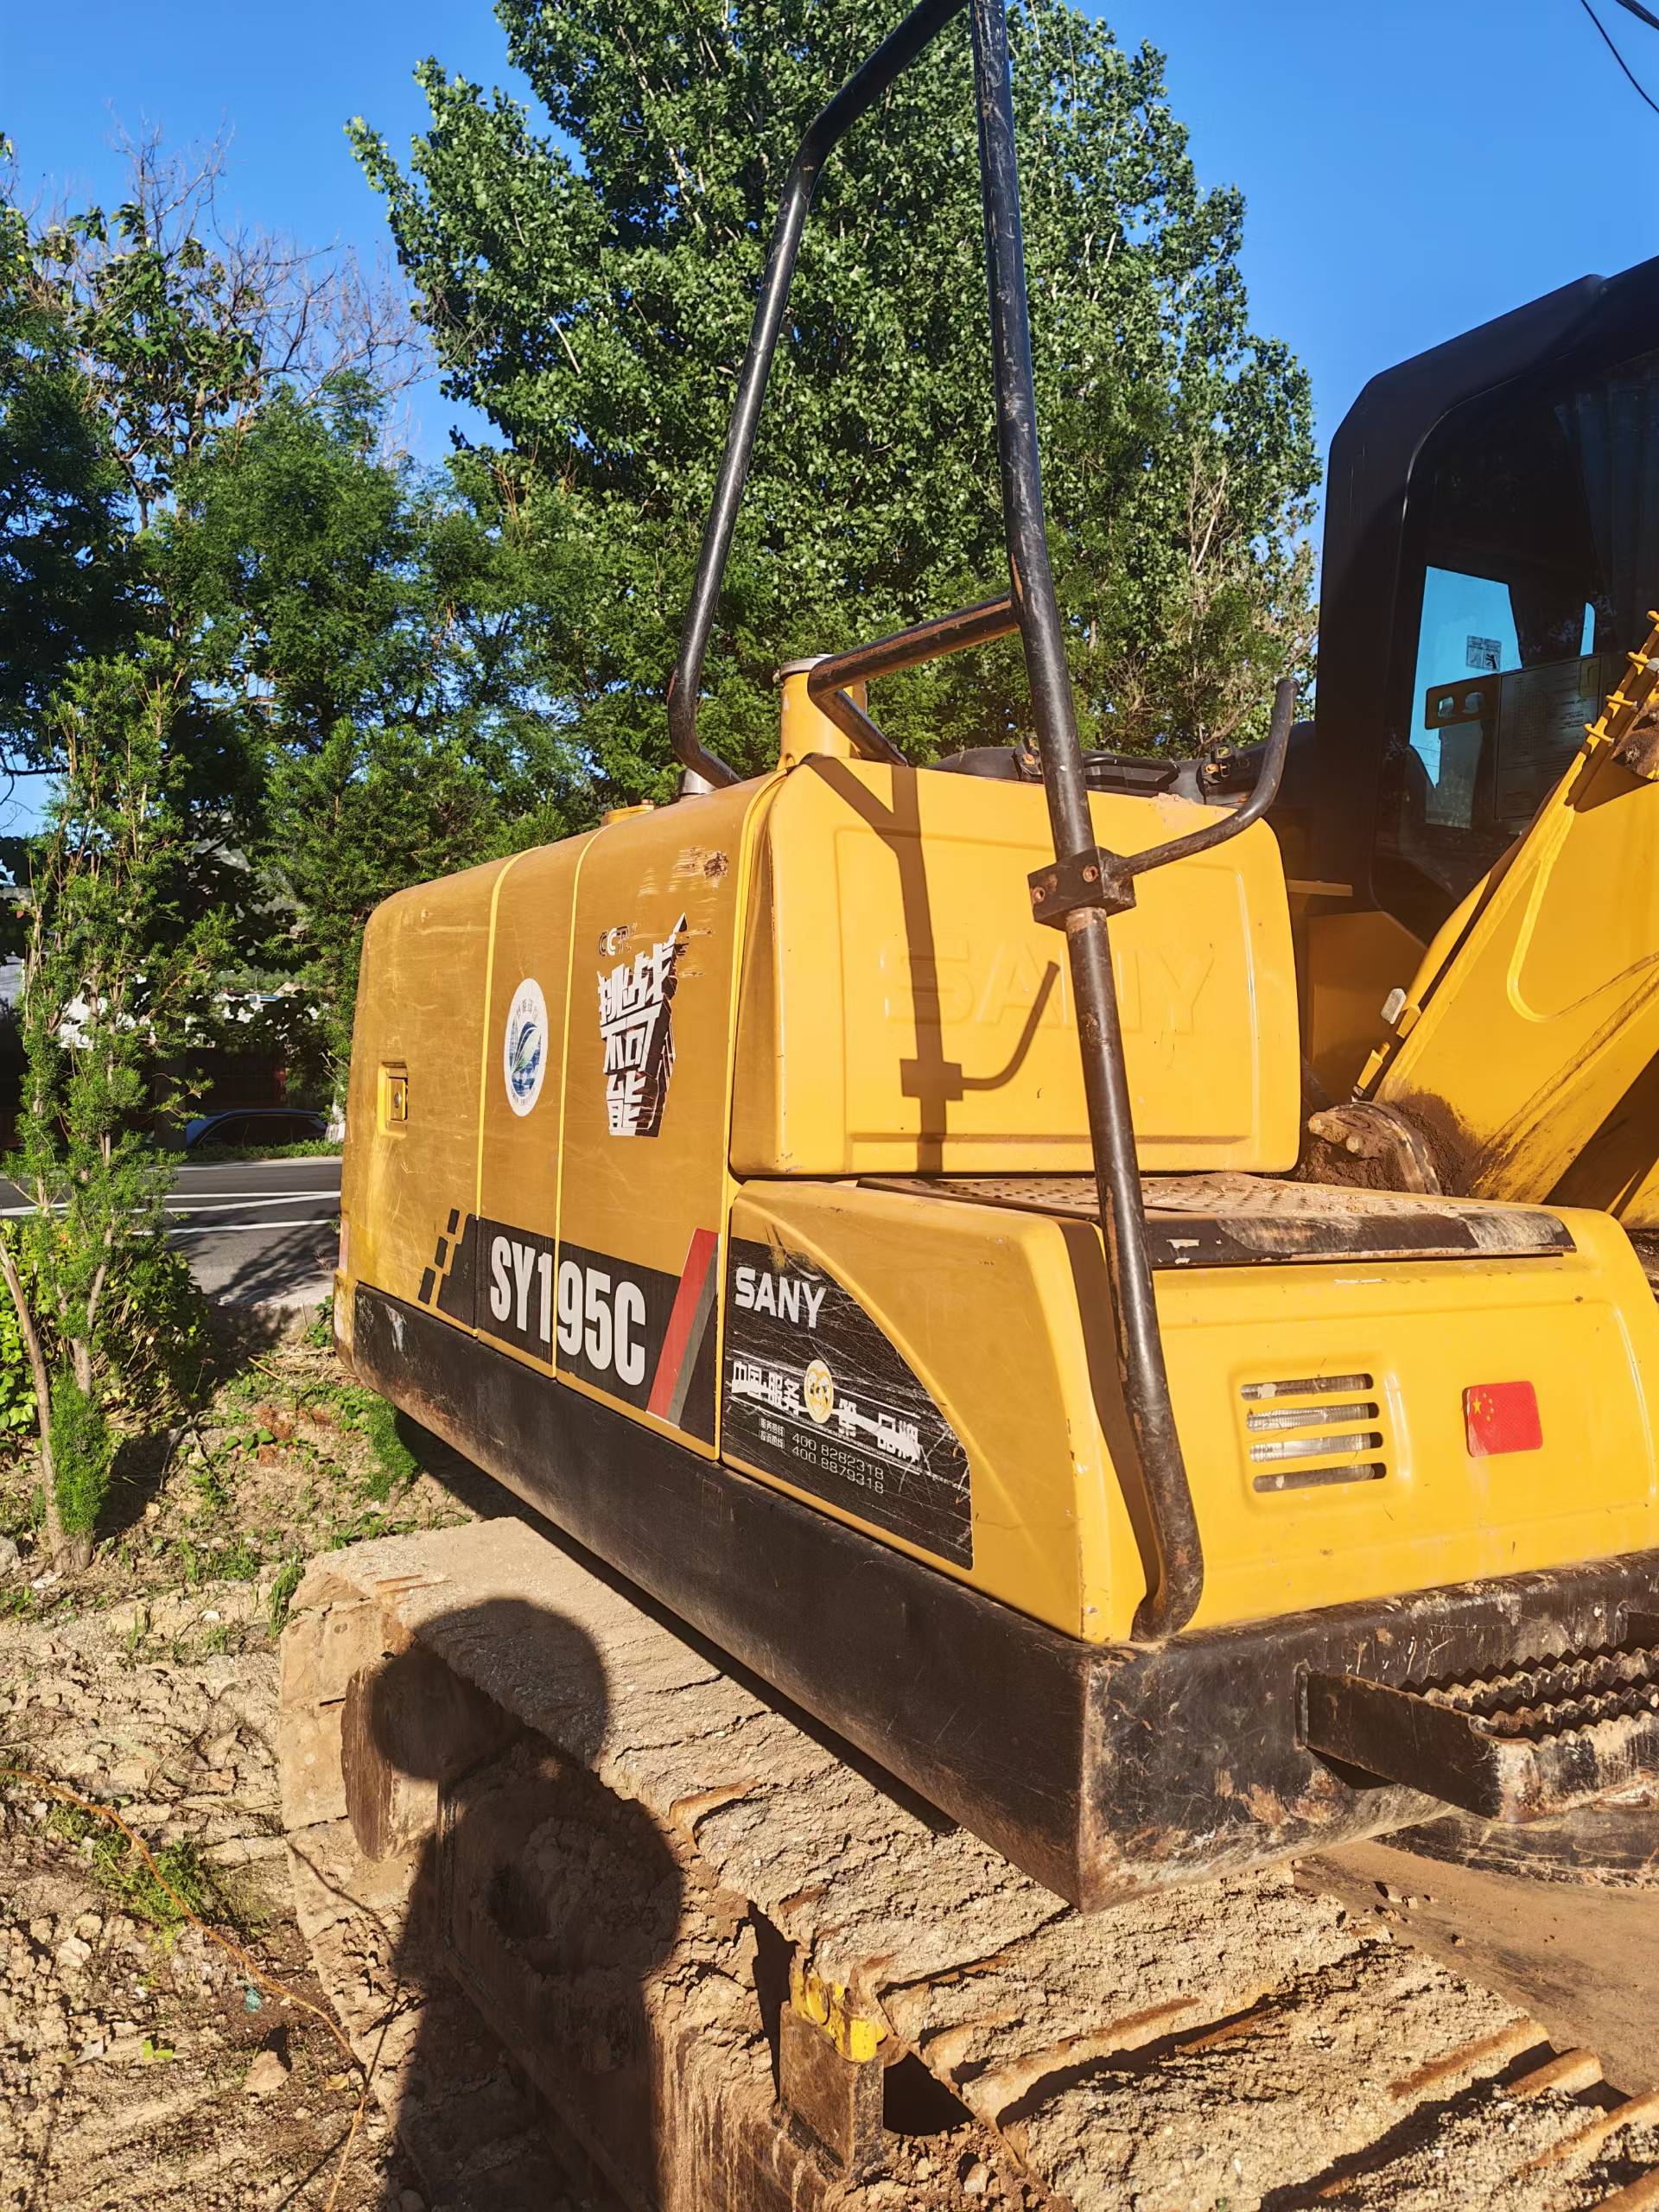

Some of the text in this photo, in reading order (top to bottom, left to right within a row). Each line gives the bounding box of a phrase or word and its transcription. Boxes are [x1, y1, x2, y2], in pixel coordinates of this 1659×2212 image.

[600, 1001, 663, 1073] 不可
[606, 1071, 647, 1130] 能
[490, 1236, 645, 1385] SY195C
[734, 1266, 827, 1328] SANY
[792, 1433, 817, 1451] 400
[821, 1444, 884, 1480] 8282318
[792, 1446, 817, 1464] 400
[821, 1458, 884, 1494] 8879318
